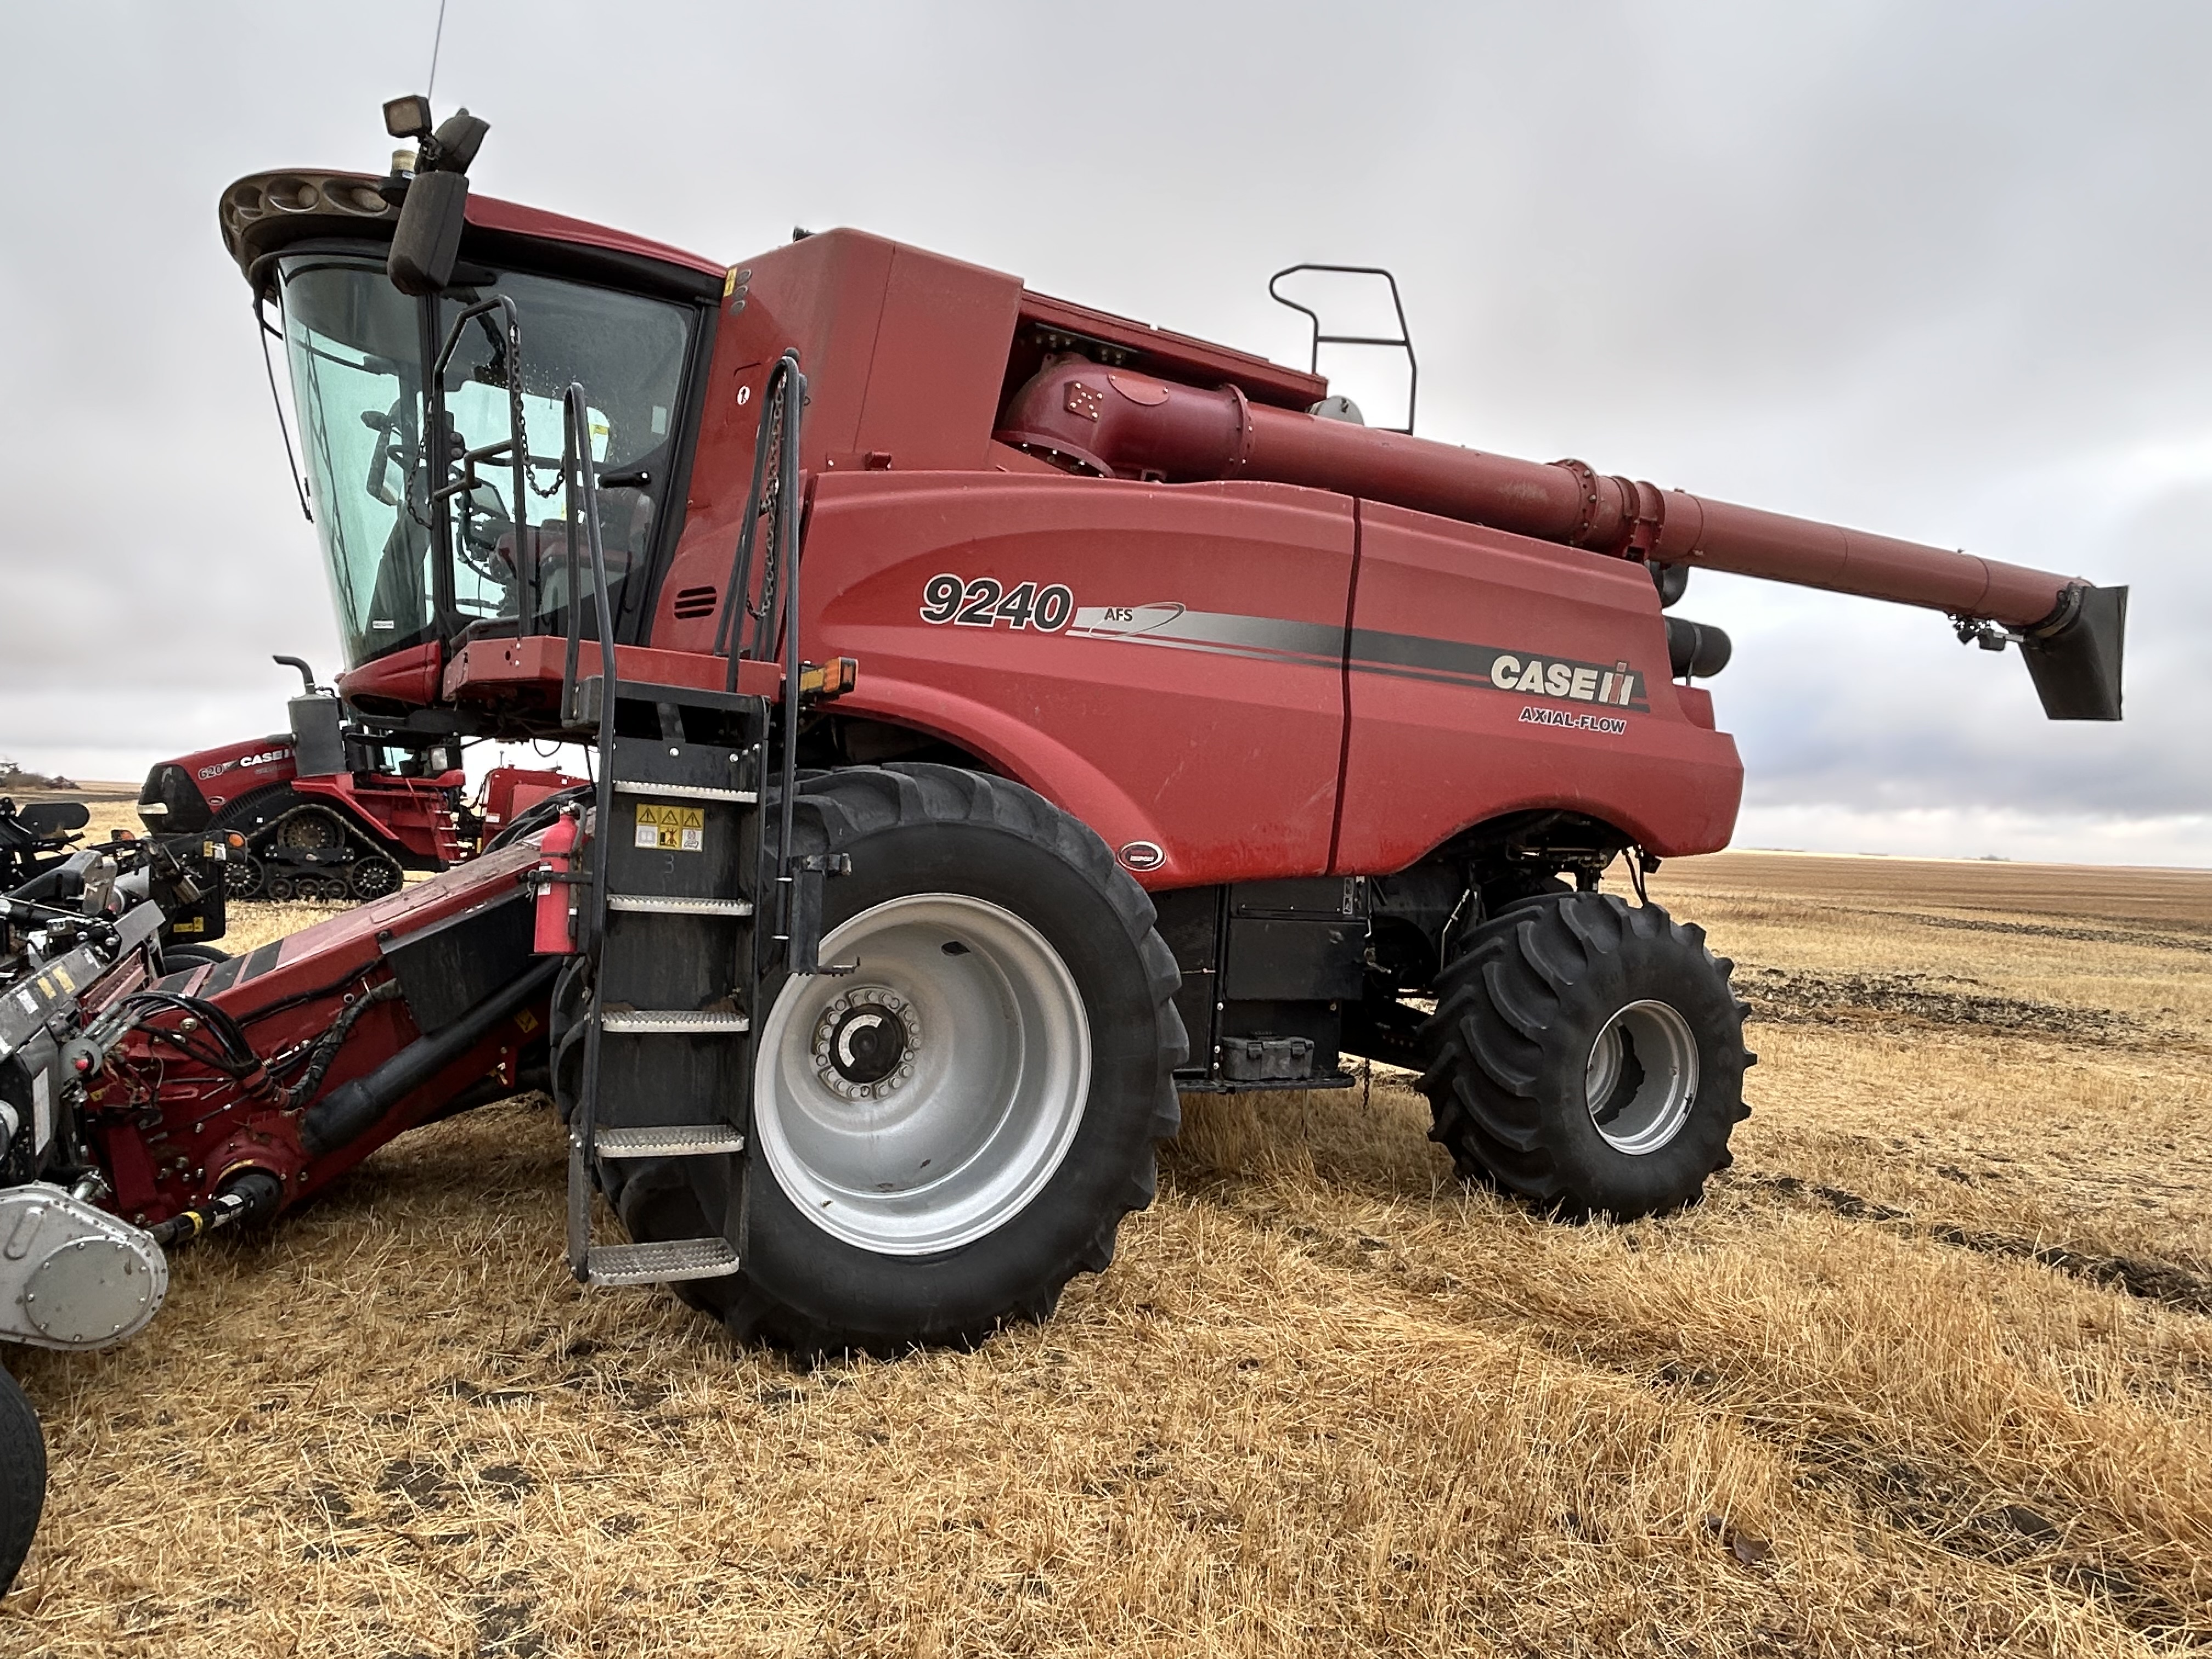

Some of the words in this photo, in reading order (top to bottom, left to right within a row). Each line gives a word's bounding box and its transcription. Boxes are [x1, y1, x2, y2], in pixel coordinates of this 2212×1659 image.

[919, 573, 1074, 632] 9240
[1104, 607, 1133, 622] AFS
[1491, 655, 1598, 700] CASE
[1519, 706, 1627, 735] AXIAL-FLOW
[240, 749, 283, 767] CASE
[198, 764, 224, 780] 620
